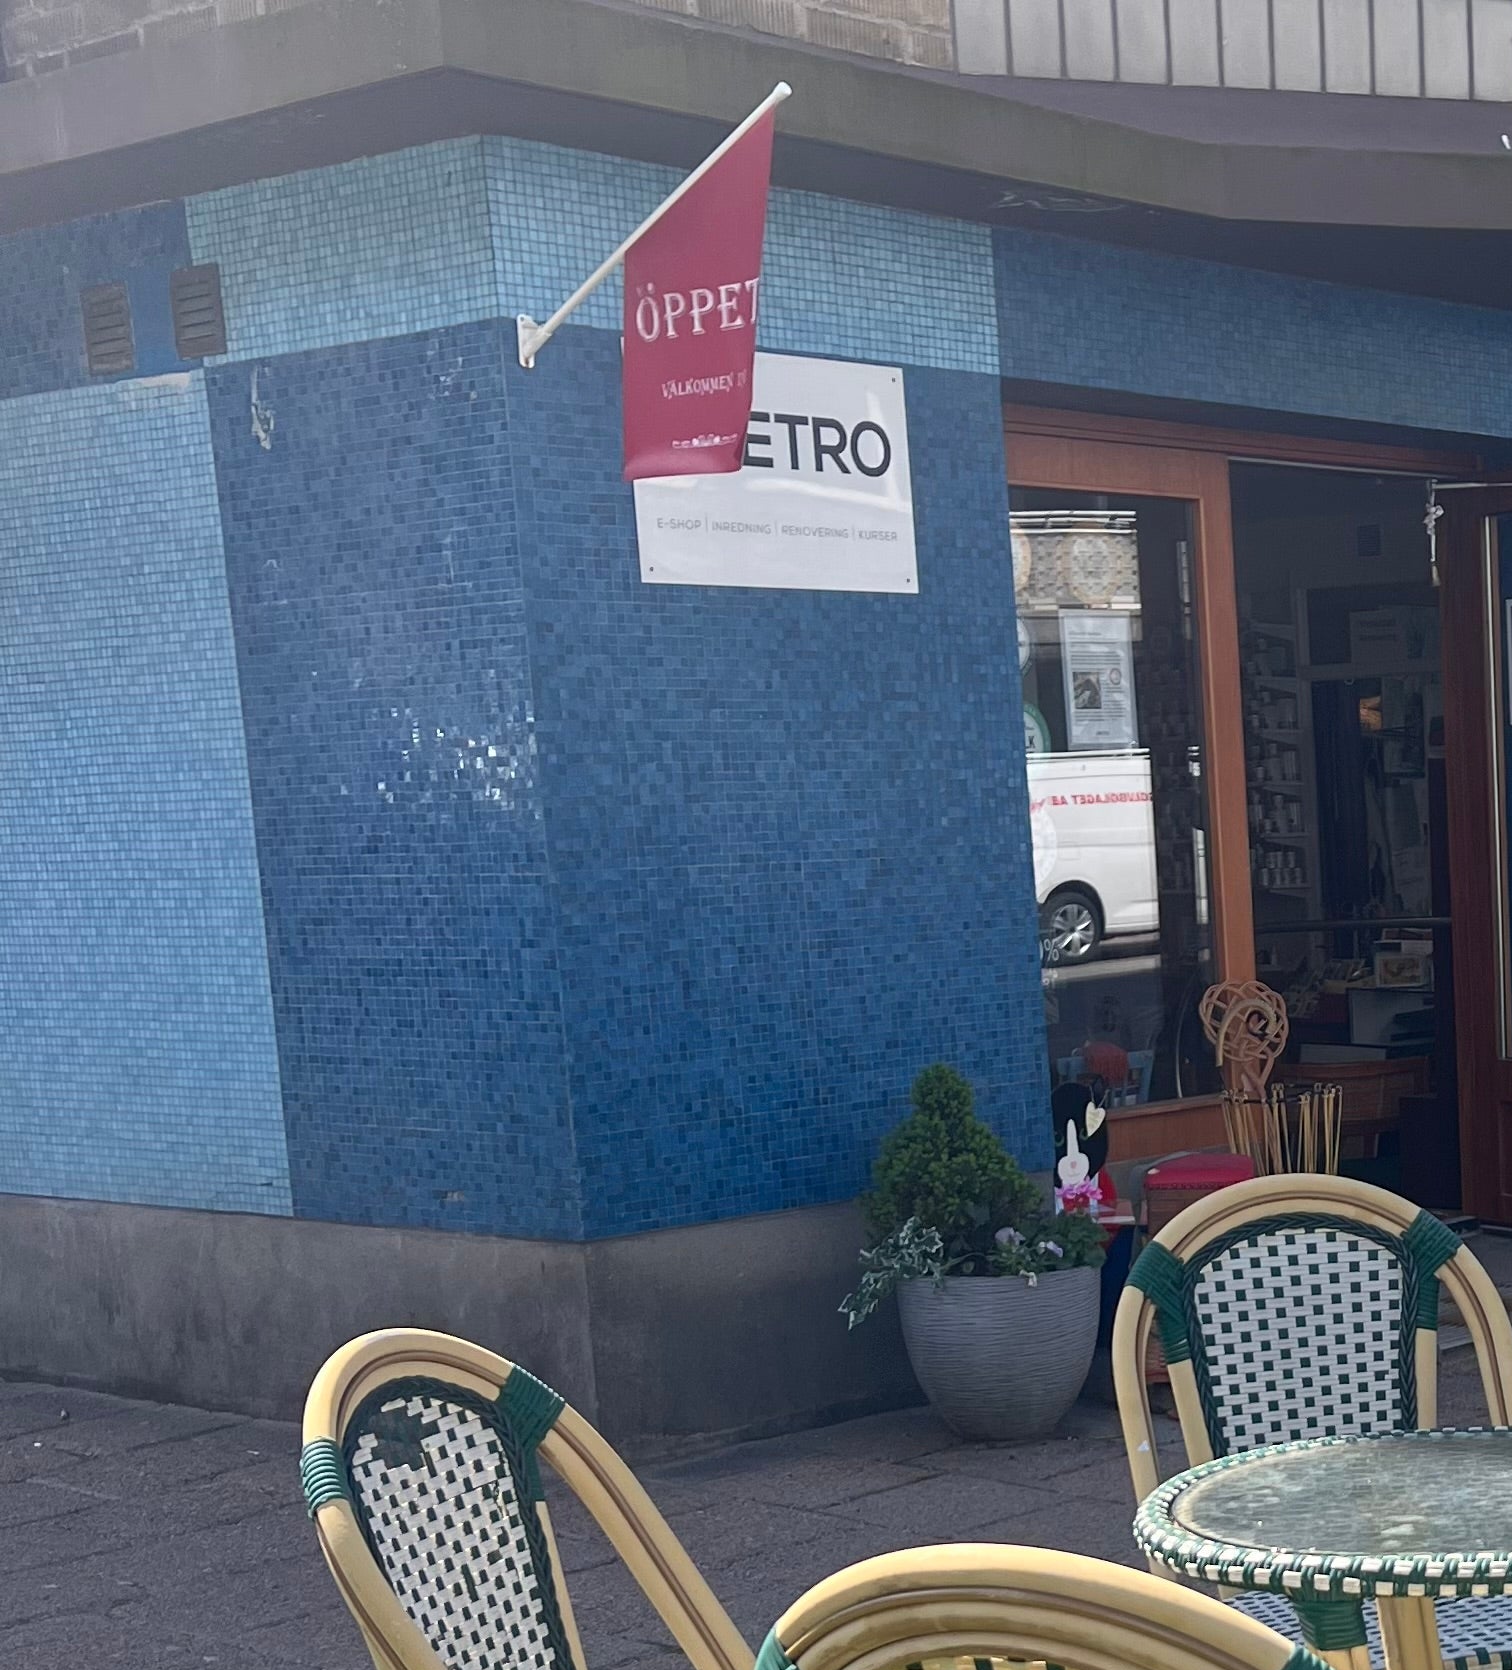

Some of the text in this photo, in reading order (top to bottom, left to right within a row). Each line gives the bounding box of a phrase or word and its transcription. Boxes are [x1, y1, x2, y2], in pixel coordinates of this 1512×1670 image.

[636, 277, 759, 343] ÖPPET
[743, 411, 892, 478] ETRO
[656, 517, 898, 542] E-SHOP INREDNING RENOVERING KURSER
